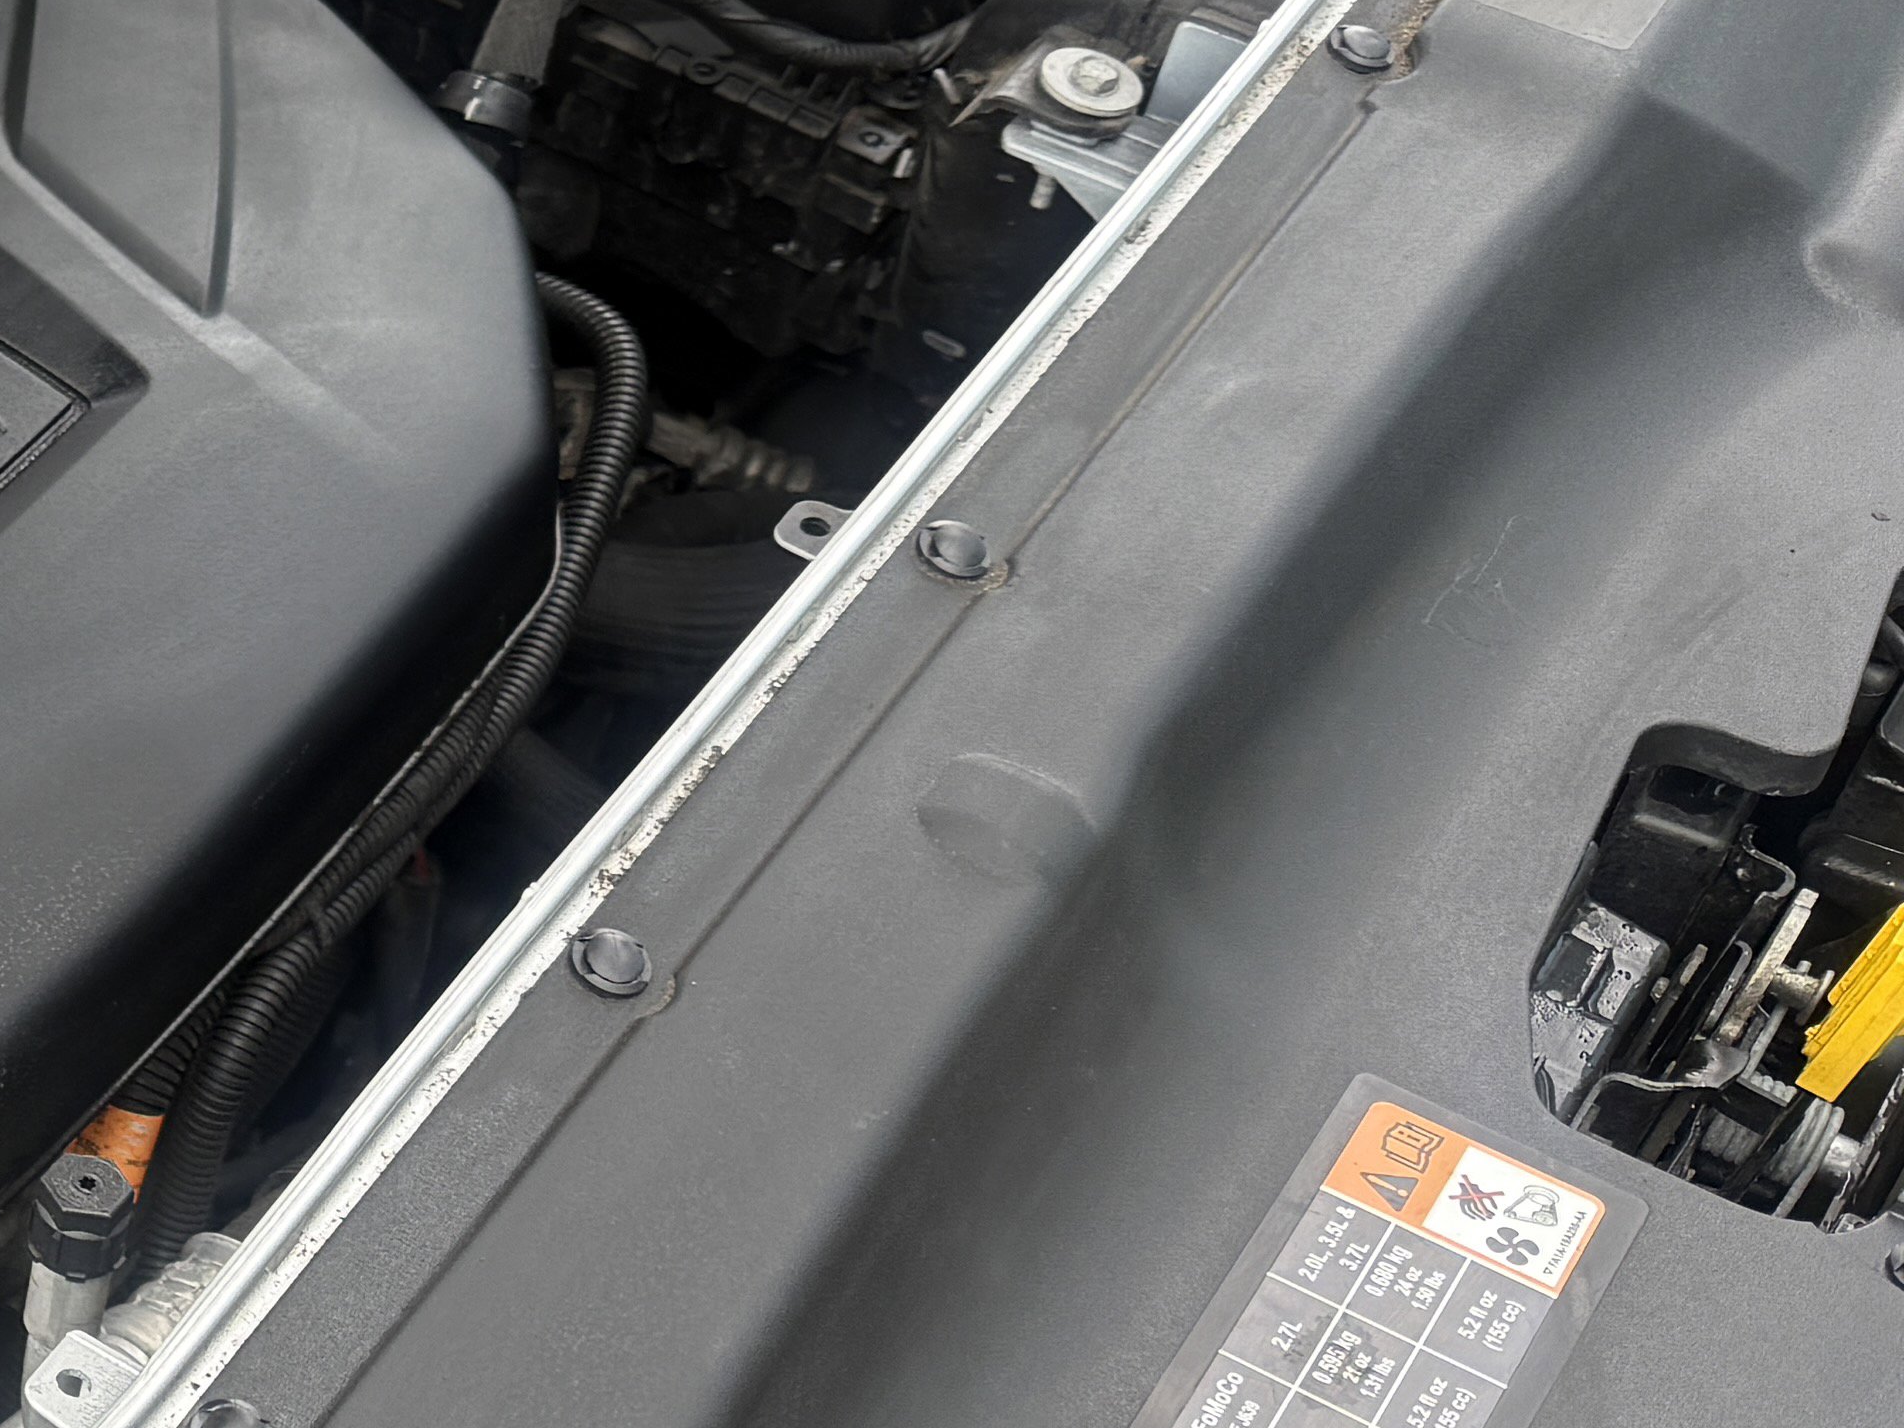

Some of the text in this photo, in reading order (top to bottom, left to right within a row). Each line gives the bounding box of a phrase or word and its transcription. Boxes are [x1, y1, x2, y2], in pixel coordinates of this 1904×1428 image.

[1297, 1250, 1335, 1283] 2.0L,
[1318, 1218, 1350, 1249] 3.5L
[1338, 1241, 1371, 1272] 3.7L
[1364, 1244, 1414, 1298] 0.680 kg
[1393, 1266, 1424, 1298] 24 oz
[1411, 1270, 1447, 1311] 1.50 lbs
[1456, 1289, 1499, 1340] 5.2 fl oz
[1482, 1299, 1528, 1353] (155 cc)
[1270, 1320, 1304, 1353] 2.7L
[1311, 1329, 1362, 1385] 0.595 kg
[1342, 1351, 1373, 1385] 21 oz
[1359, 1357, 1396, 1399] 1.31 lbs
[1428, 1376, 1449, 1396] oz
[1418, 1392, 1439, 1408] fl
[1451, 1386, 1478, 1412] cc)
